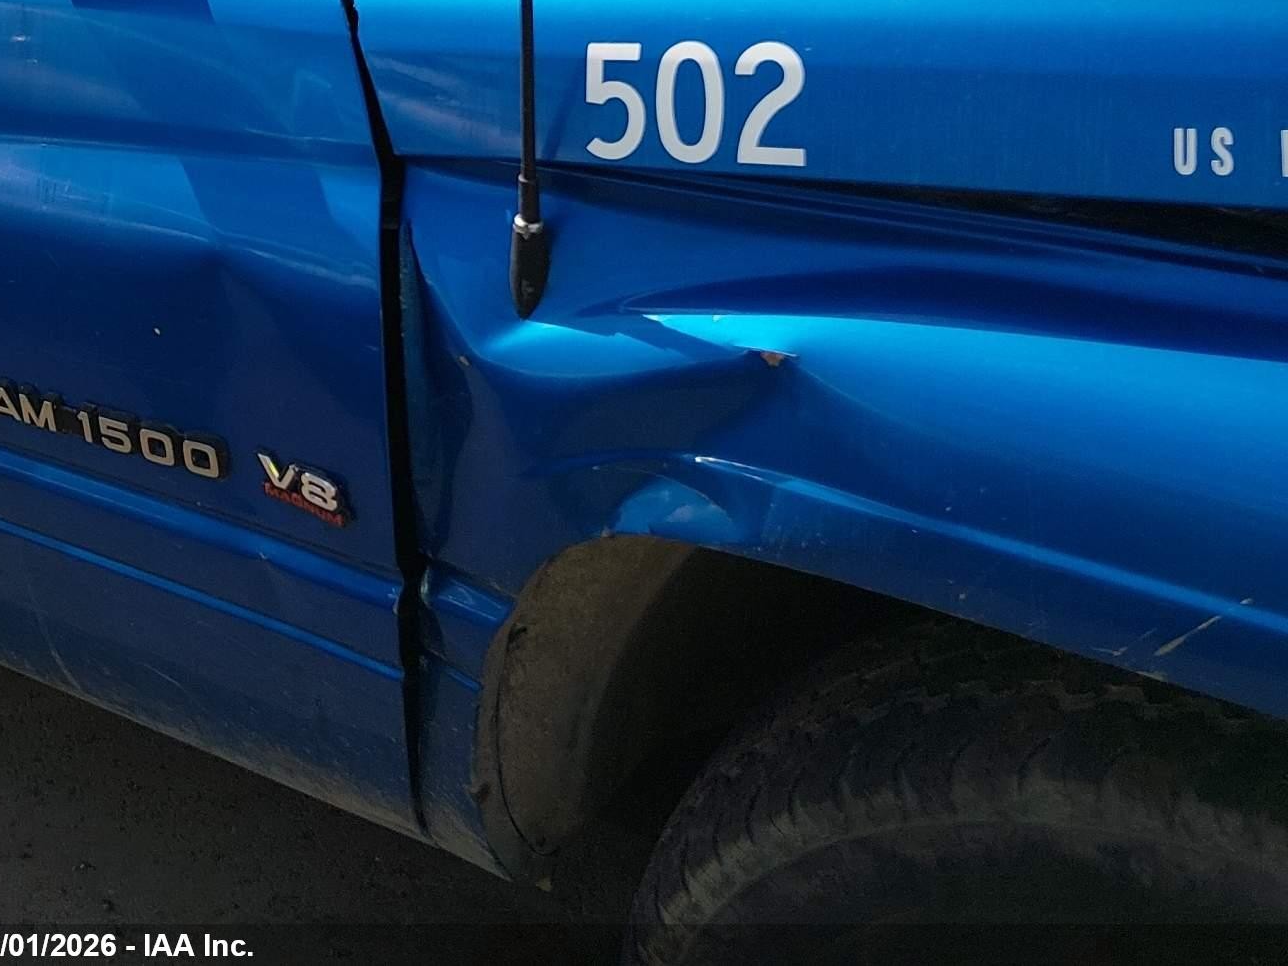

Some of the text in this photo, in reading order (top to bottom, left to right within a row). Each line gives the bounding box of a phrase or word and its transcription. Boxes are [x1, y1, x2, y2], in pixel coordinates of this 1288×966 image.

[585, 40, 807, 167] 502
[1173, 126, 1234, 176] US
[77, 410, 220, 479] 1500
[257, 453, 338, 512] V8
